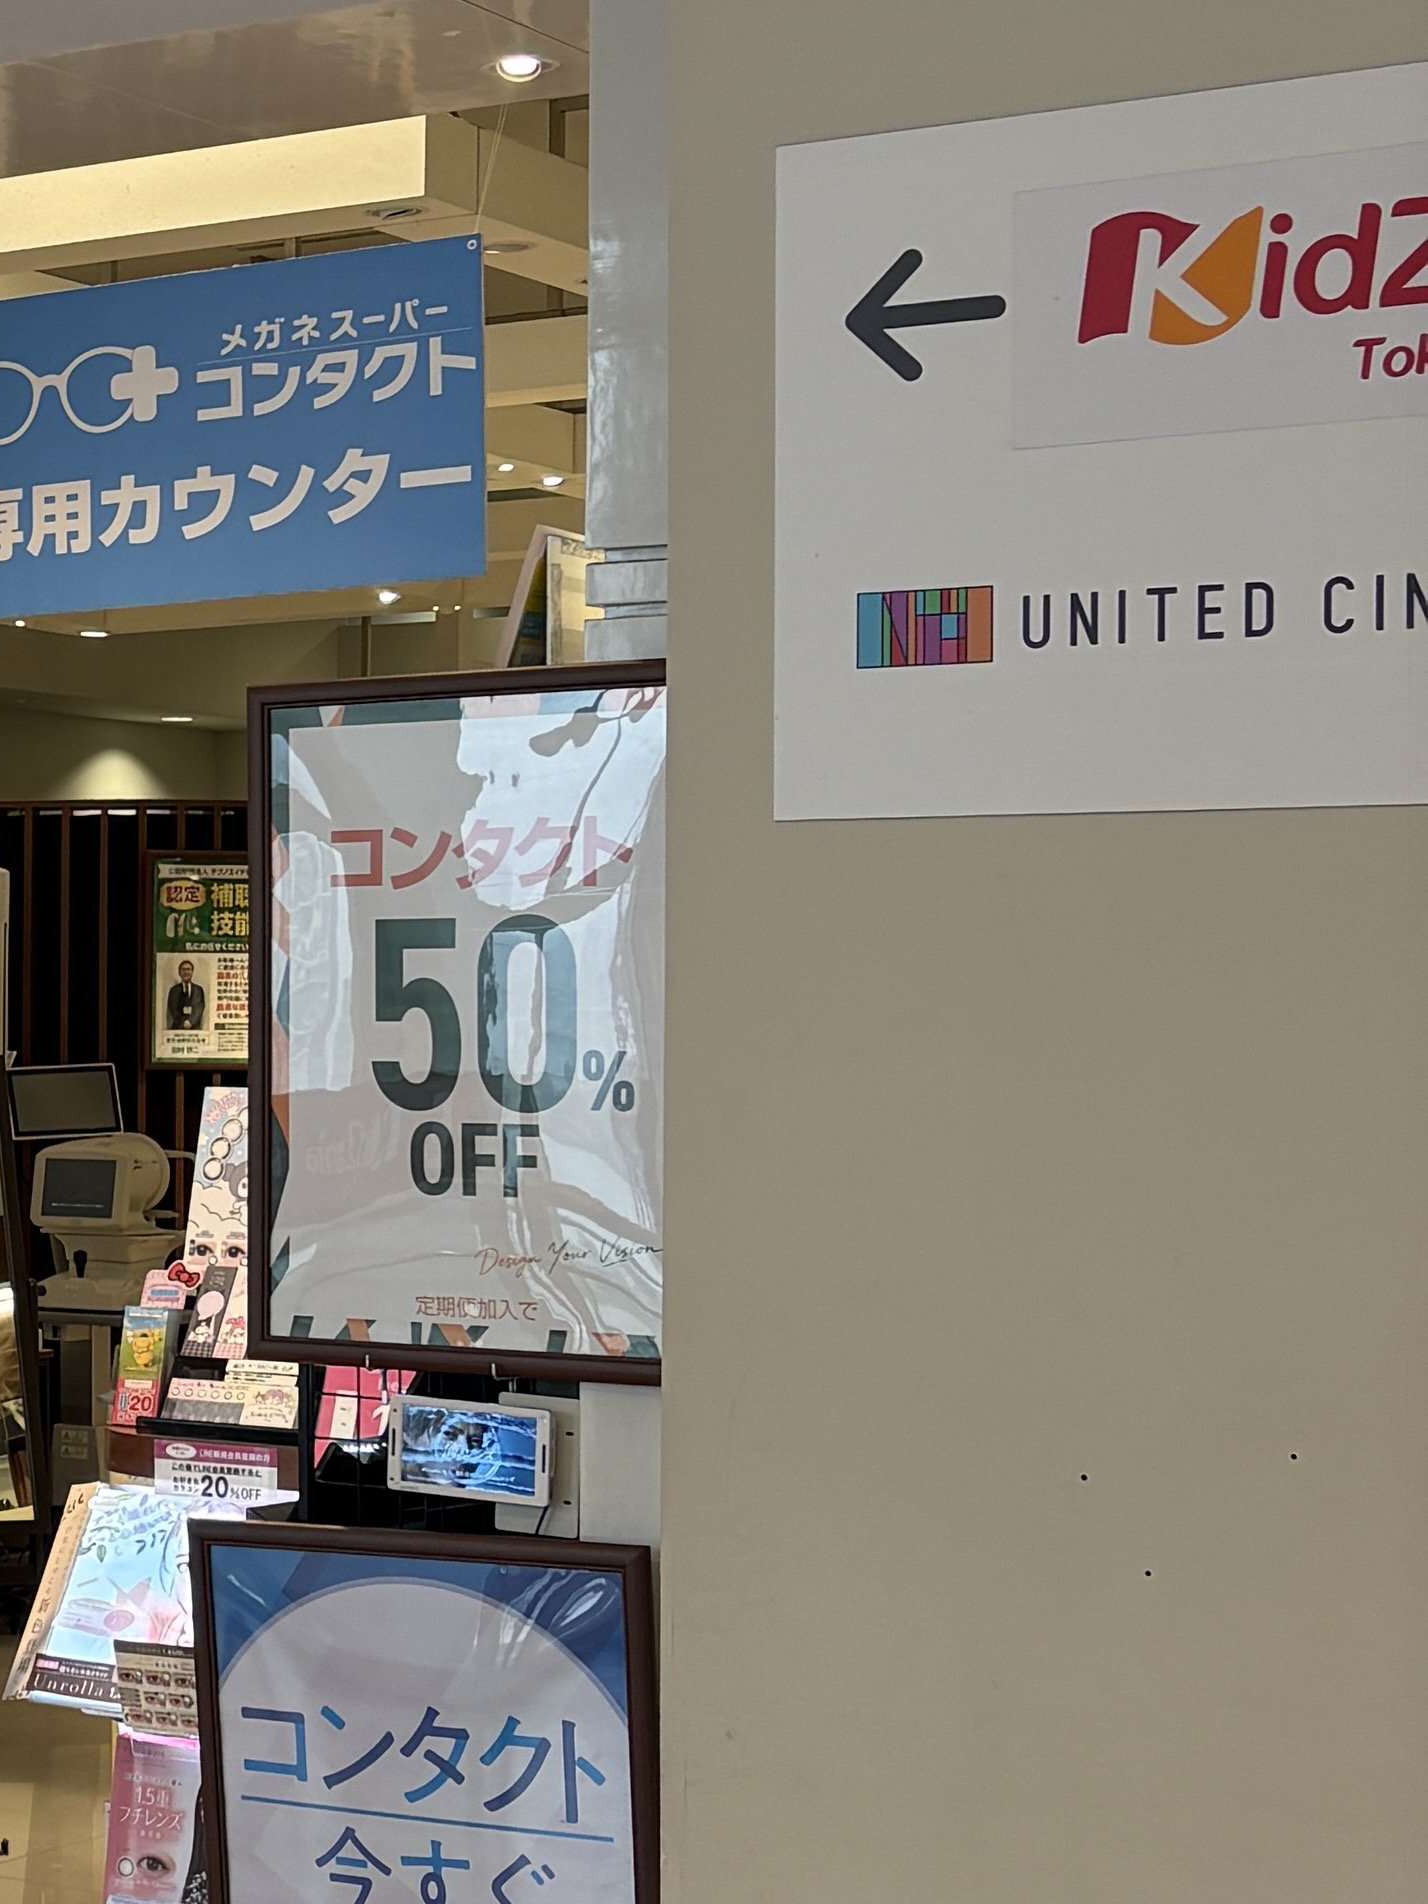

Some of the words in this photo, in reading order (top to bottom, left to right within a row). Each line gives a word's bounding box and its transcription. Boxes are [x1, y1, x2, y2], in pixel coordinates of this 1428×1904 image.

[220, 300, 448, 356] メガネスーパー
[196, 333, 476, 422] コンタクト
[1022, 582, 1275, 649] UNITED
[330, 815, 633, 890] コンタクト
[166, 885, 201, 904] 認定
[410, 1122, 540, 1197] OFF
[474, 1247, 539, 1277] Design
[548, 1242, 592, 1274] Your
[599, 1238, 663, 1268] Vision
[415, 1295, 539, 1322] 定期便加入で
[241, 1704, 606, 1825] コンタクト
[119, 1806, 183, 1831] フチレンズ
